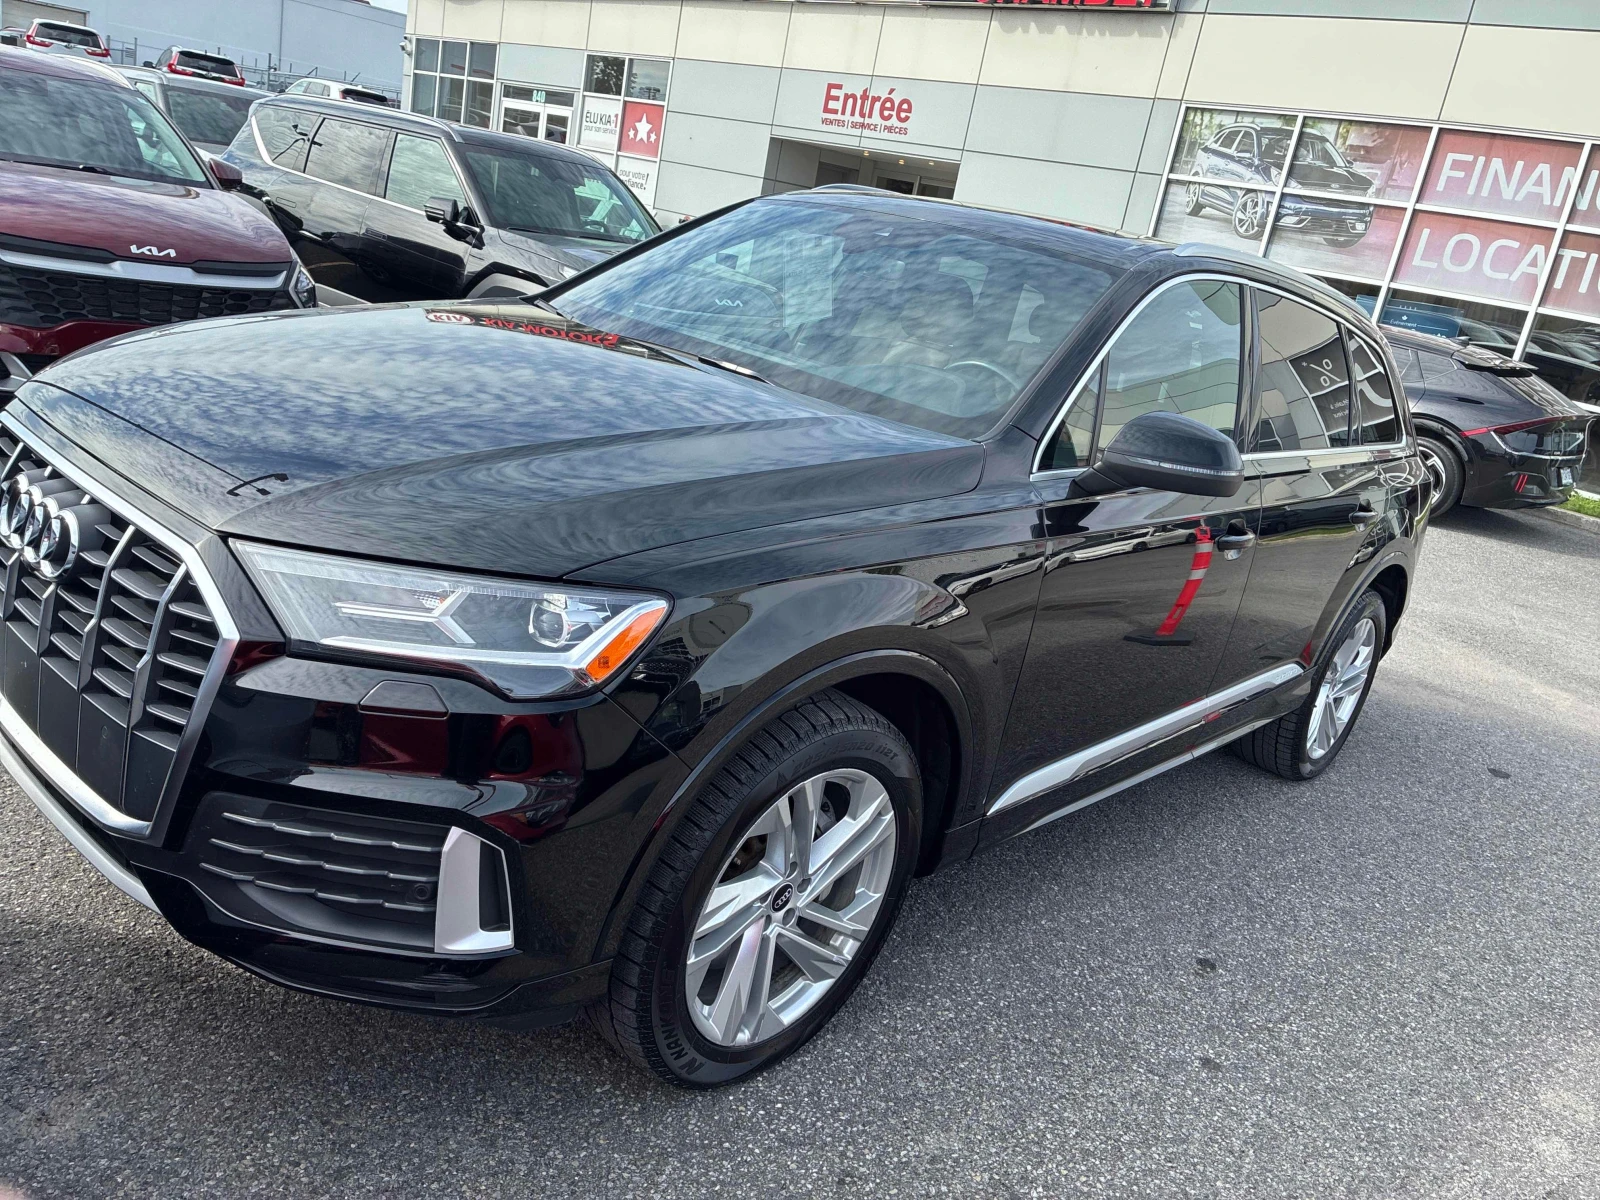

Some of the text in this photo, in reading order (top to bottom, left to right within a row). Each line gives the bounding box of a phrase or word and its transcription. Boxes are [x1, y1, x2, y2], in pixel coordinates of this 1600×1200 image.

[532, 90, 546, 103] 840
[822, 83, 913, 123] Entrée
[585, 110, 599, 125] ÉLU
[599, 113, 611, 127] KIA
[821, 117, 908, 136] VENTES SERVICE PIÈCES
[602, 127, 618, 136] service
[619, 170, 645, 180] pour votre
[1436, 153, 1600, 212] FINAN
[1412, 228, 1600, 293] LOCATI
